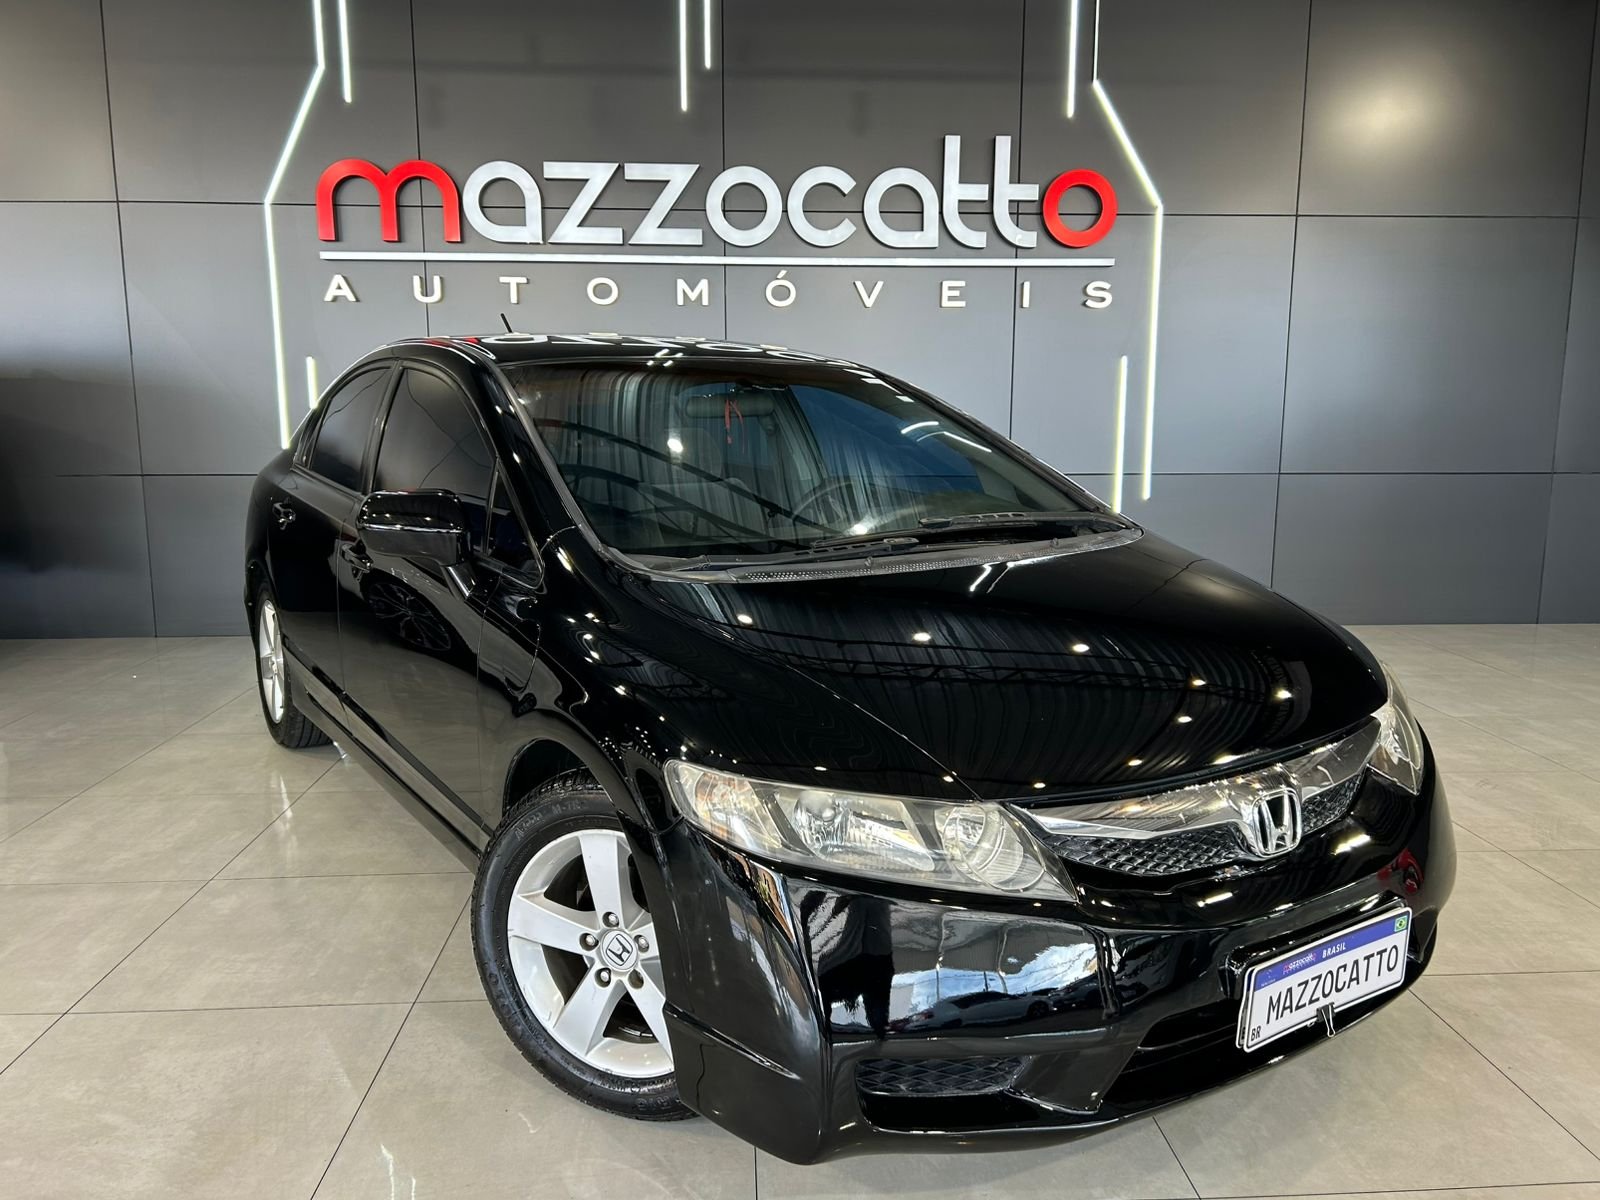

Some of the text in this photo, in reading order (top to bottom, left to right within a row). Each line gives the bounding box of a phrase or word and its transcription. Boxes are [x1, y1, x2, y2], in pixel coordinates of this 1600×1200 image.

[316, 134, 1119, 249] mazzocatto
[323, 270, 1113, 309] AUTOMÓVEIS
[1323, 943, 1347, 958] BRASIL
[1266, 944, 1399, 1025] MAZZOCATTO
[1251, 1025, 1262, 1042] BR
